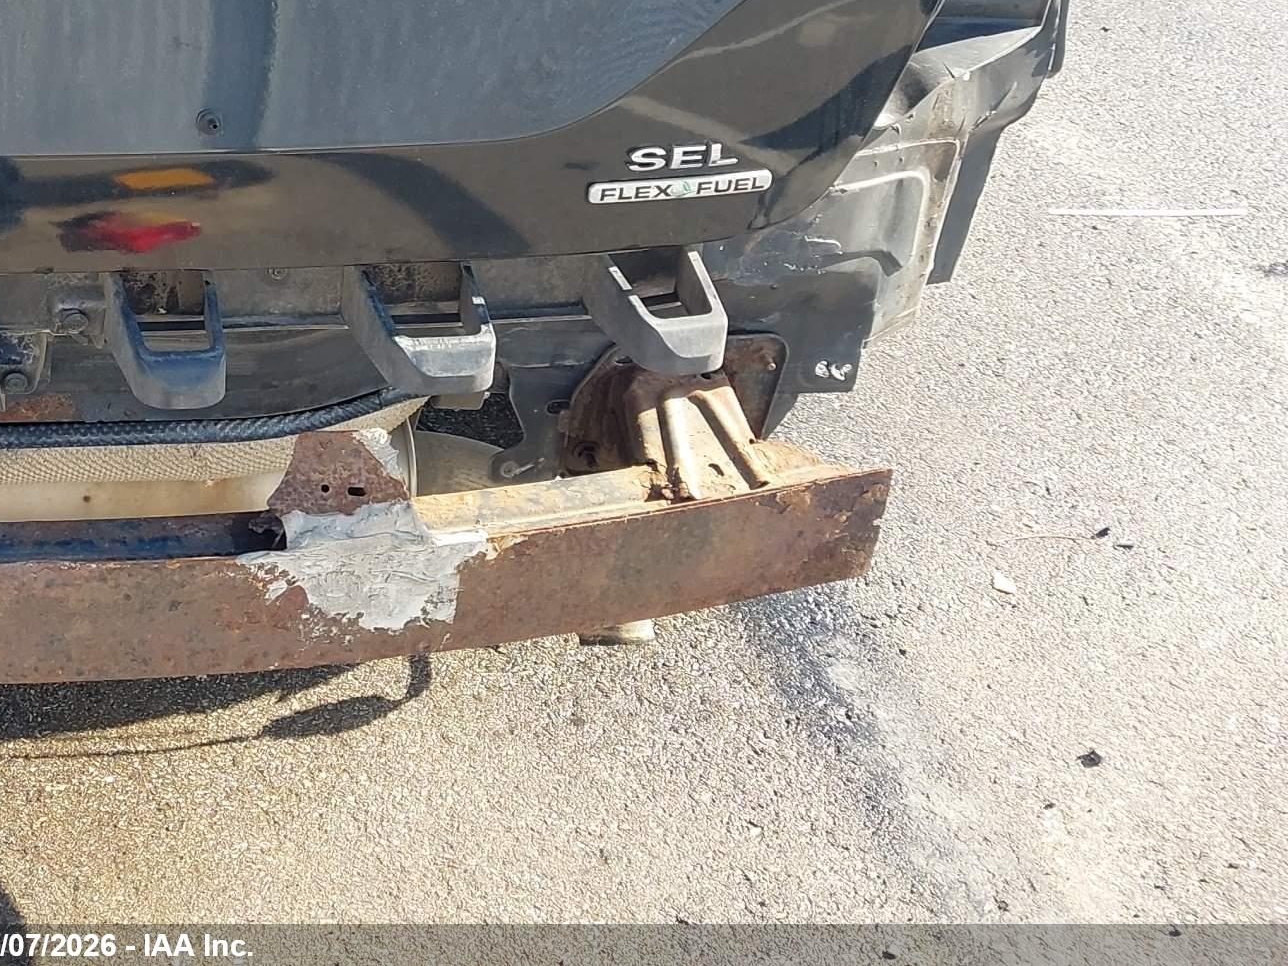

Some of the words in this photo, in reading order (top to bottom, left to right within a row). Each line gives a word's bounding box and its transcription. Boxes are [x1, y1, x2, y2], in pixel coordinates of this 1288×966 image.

[628, 143, 739, 172] SEL
[599, 184, 673, 202] FLEX
[695, 177, 765, 196] FUEL
